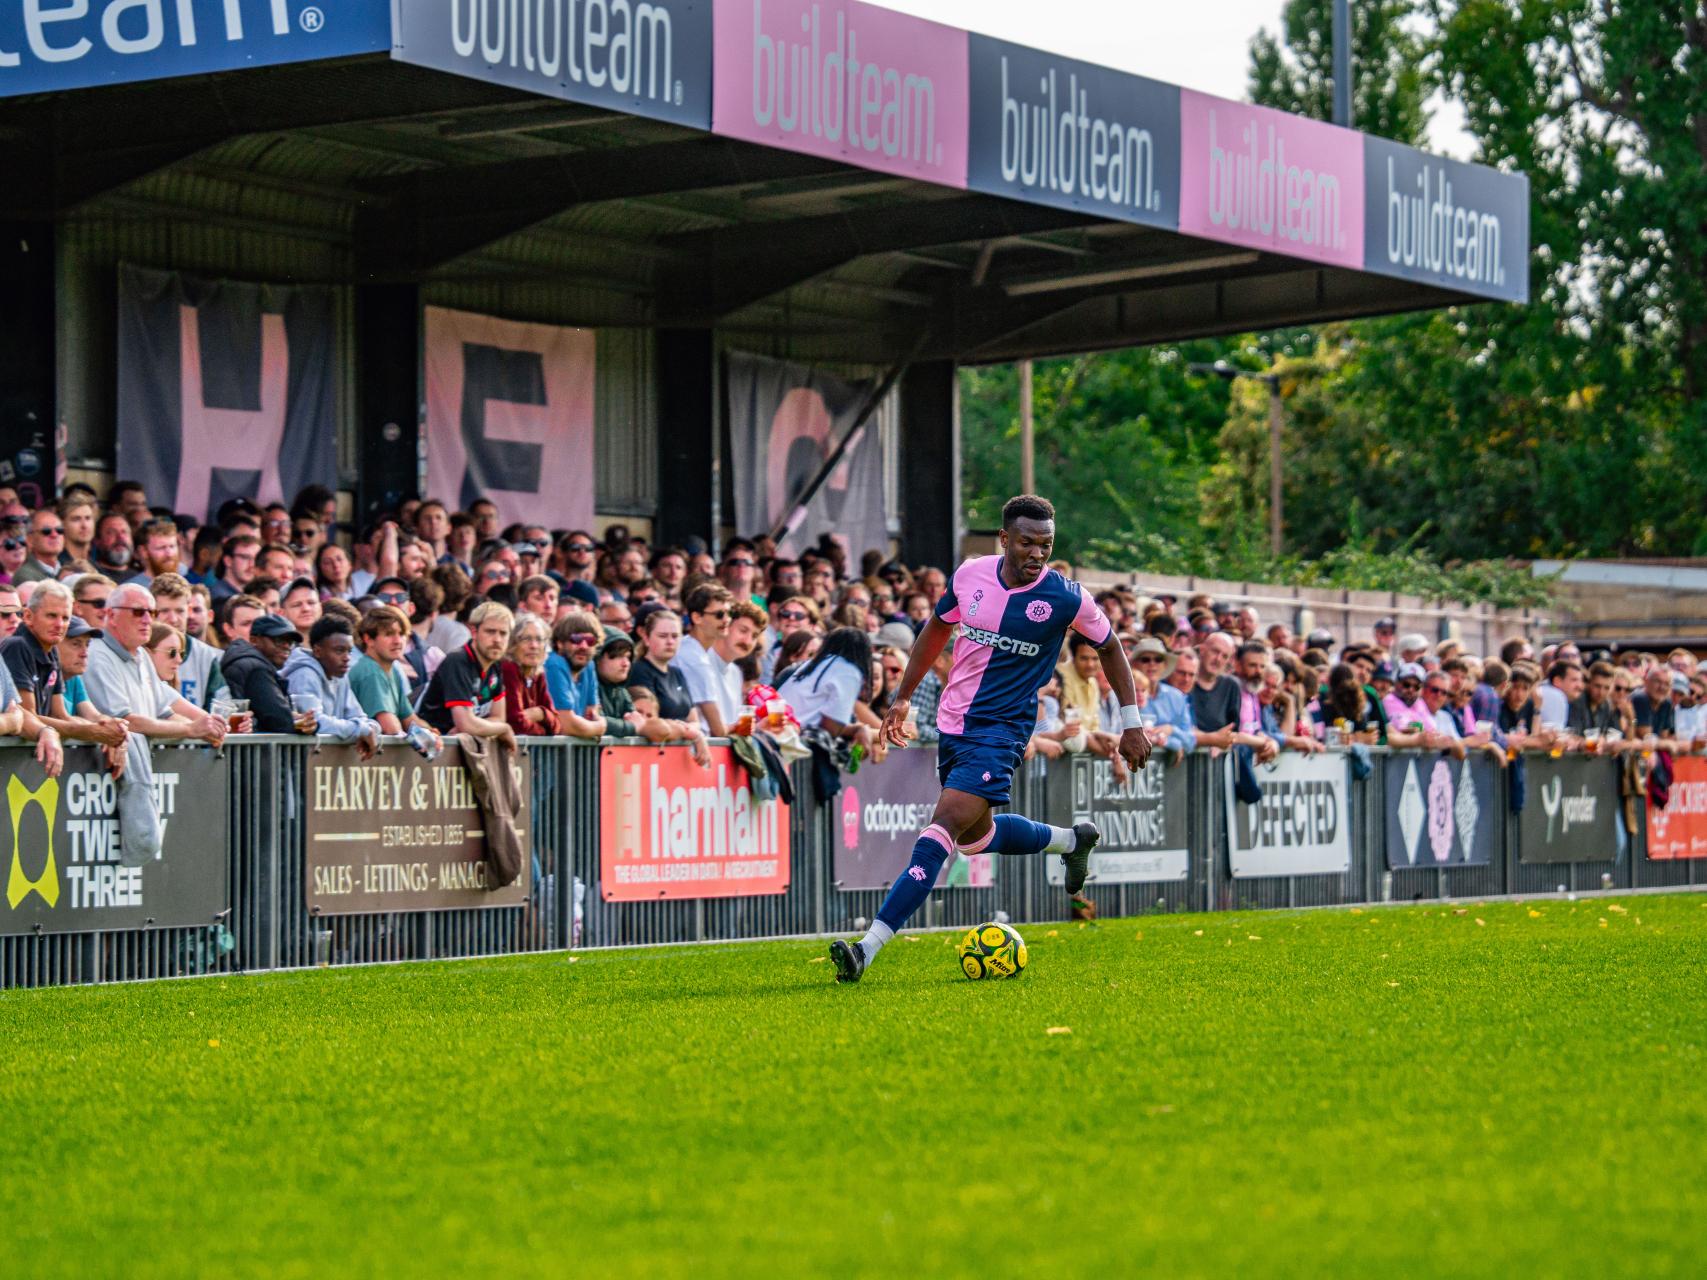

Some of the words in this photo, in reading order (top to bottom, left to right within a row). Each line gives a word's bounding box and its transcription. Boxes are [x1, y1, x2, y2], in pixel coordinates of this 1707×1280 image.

[968, 601, 979, 616] 2
[961, 624, 1040, 657] DEFECTED
[314, 766, 405, 811] HARVEY
[409, 766, 429, 810] &
[650, 763, 778, 859] harnham
[1093, 810, 1158, 847] WINDOWS
[1236, 780, 1337, 851] DEFECTED
[382, 825, 443, 847] ESTABLISHED
[66, 865, 143, 908] THREE
[314, 865, 352, 895] SALES
[363, 862, 429, 893] LETTINGS
